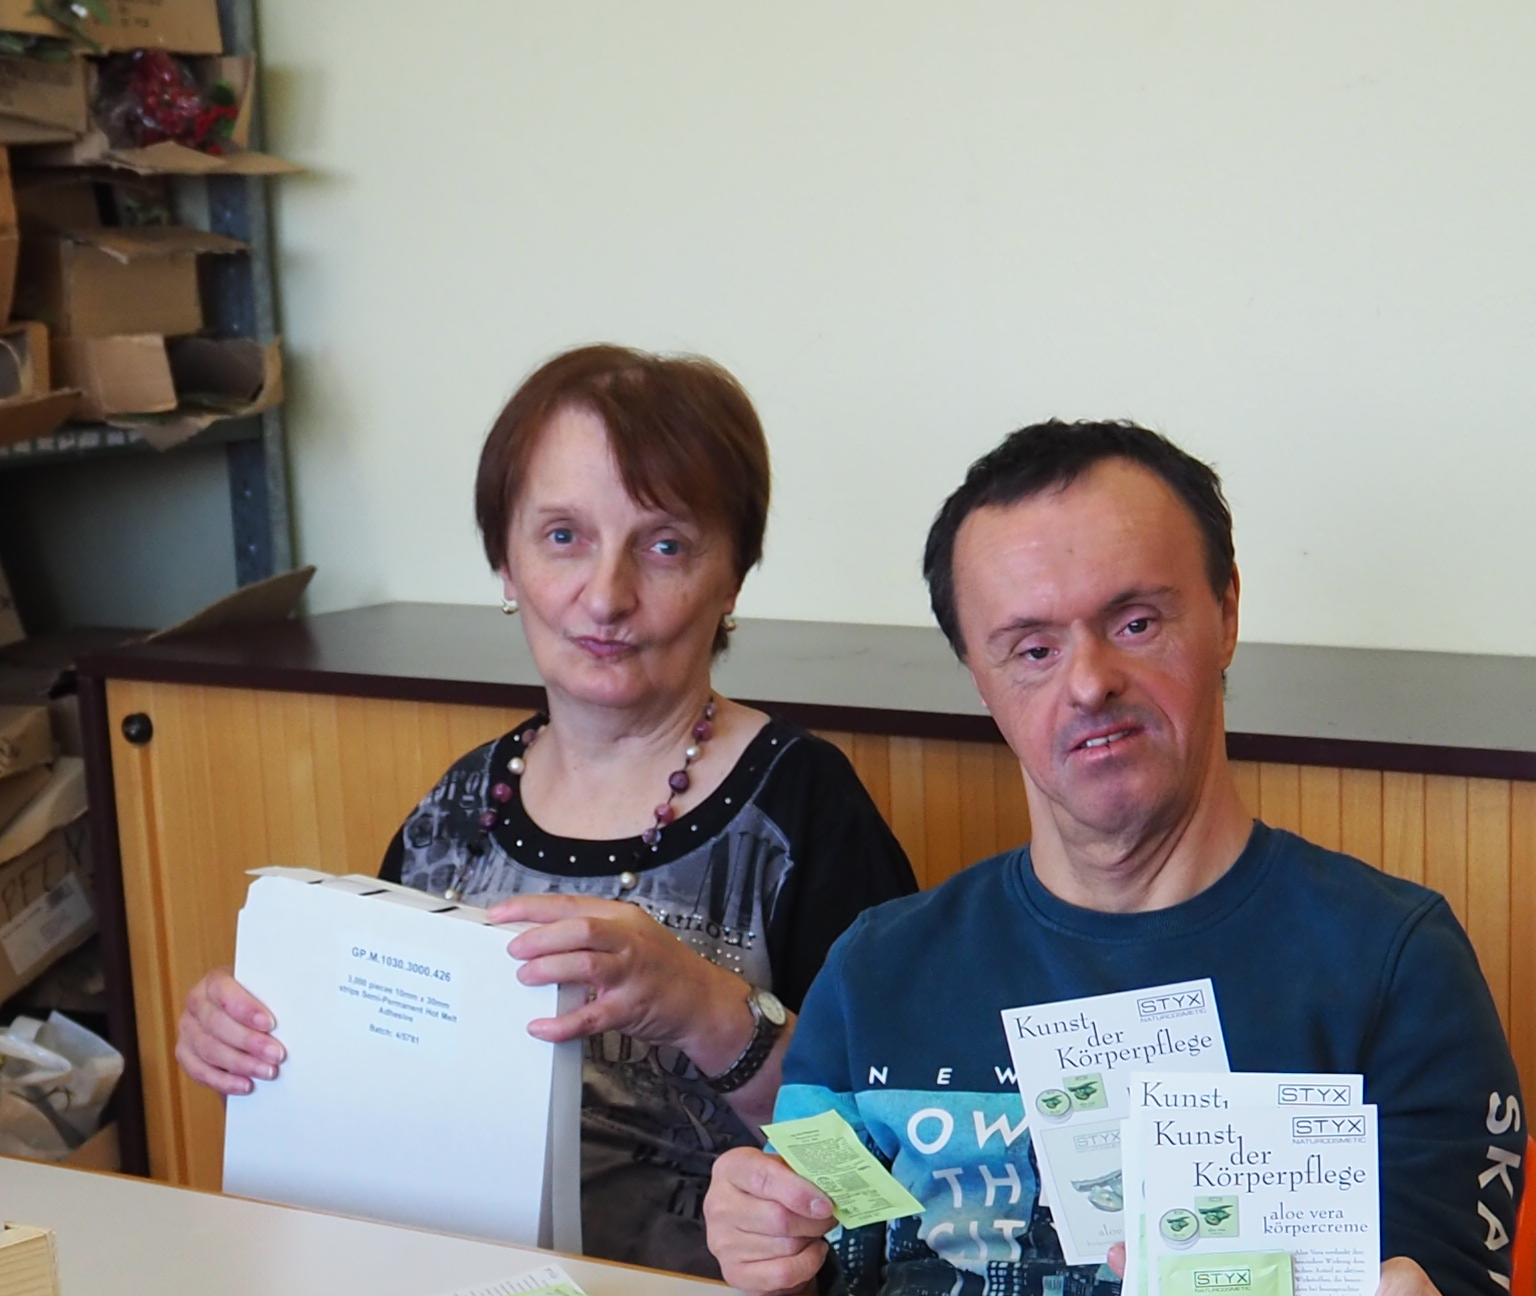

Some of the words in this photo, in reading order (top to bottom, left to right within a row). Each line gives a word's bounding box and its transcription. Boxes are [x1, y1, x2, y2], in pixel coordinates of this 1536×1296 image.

[351, 946, 452, 982] GP.M.1030.3000.426
[339, 985, 360, 997] strips
[362, 989, 424, 1015] Semi-Permanent
[425, 1008, 439, 1019] Hot
[441, 1011, 458, 1023] Melt
[369, 982, 393, 995] pieces
[396, 988, 419, 1002] 10mm
[379, 1006, 414, 1023] Adhesive
[1014, 1011, 1091, 1041] Kunst
[1140, 992, 1203, 1014] STYX
[1086, 1020, 1125, 1049] der
[1055, 1028, 1214, 1071] Körperpflege
[1141, 1080, 1223, 1110] Kunst
[1281, 1087, 1348, 1103] STYX
[1153, 1119, 1237, 1147] Kunst
[1296, 1118, 1362, 1134] STYX
[1229, 1134, 1273, 1166] der
[1192, 1154, 1367, 1194] Körperpflege
[1269, 1201, 1305, 1221] aloe
[1310, 1209, 1345, 1220] vera
[1262, 1216, 1369, 1238] körpercreme
[1196, 1271, 1249, 1286] STYX
